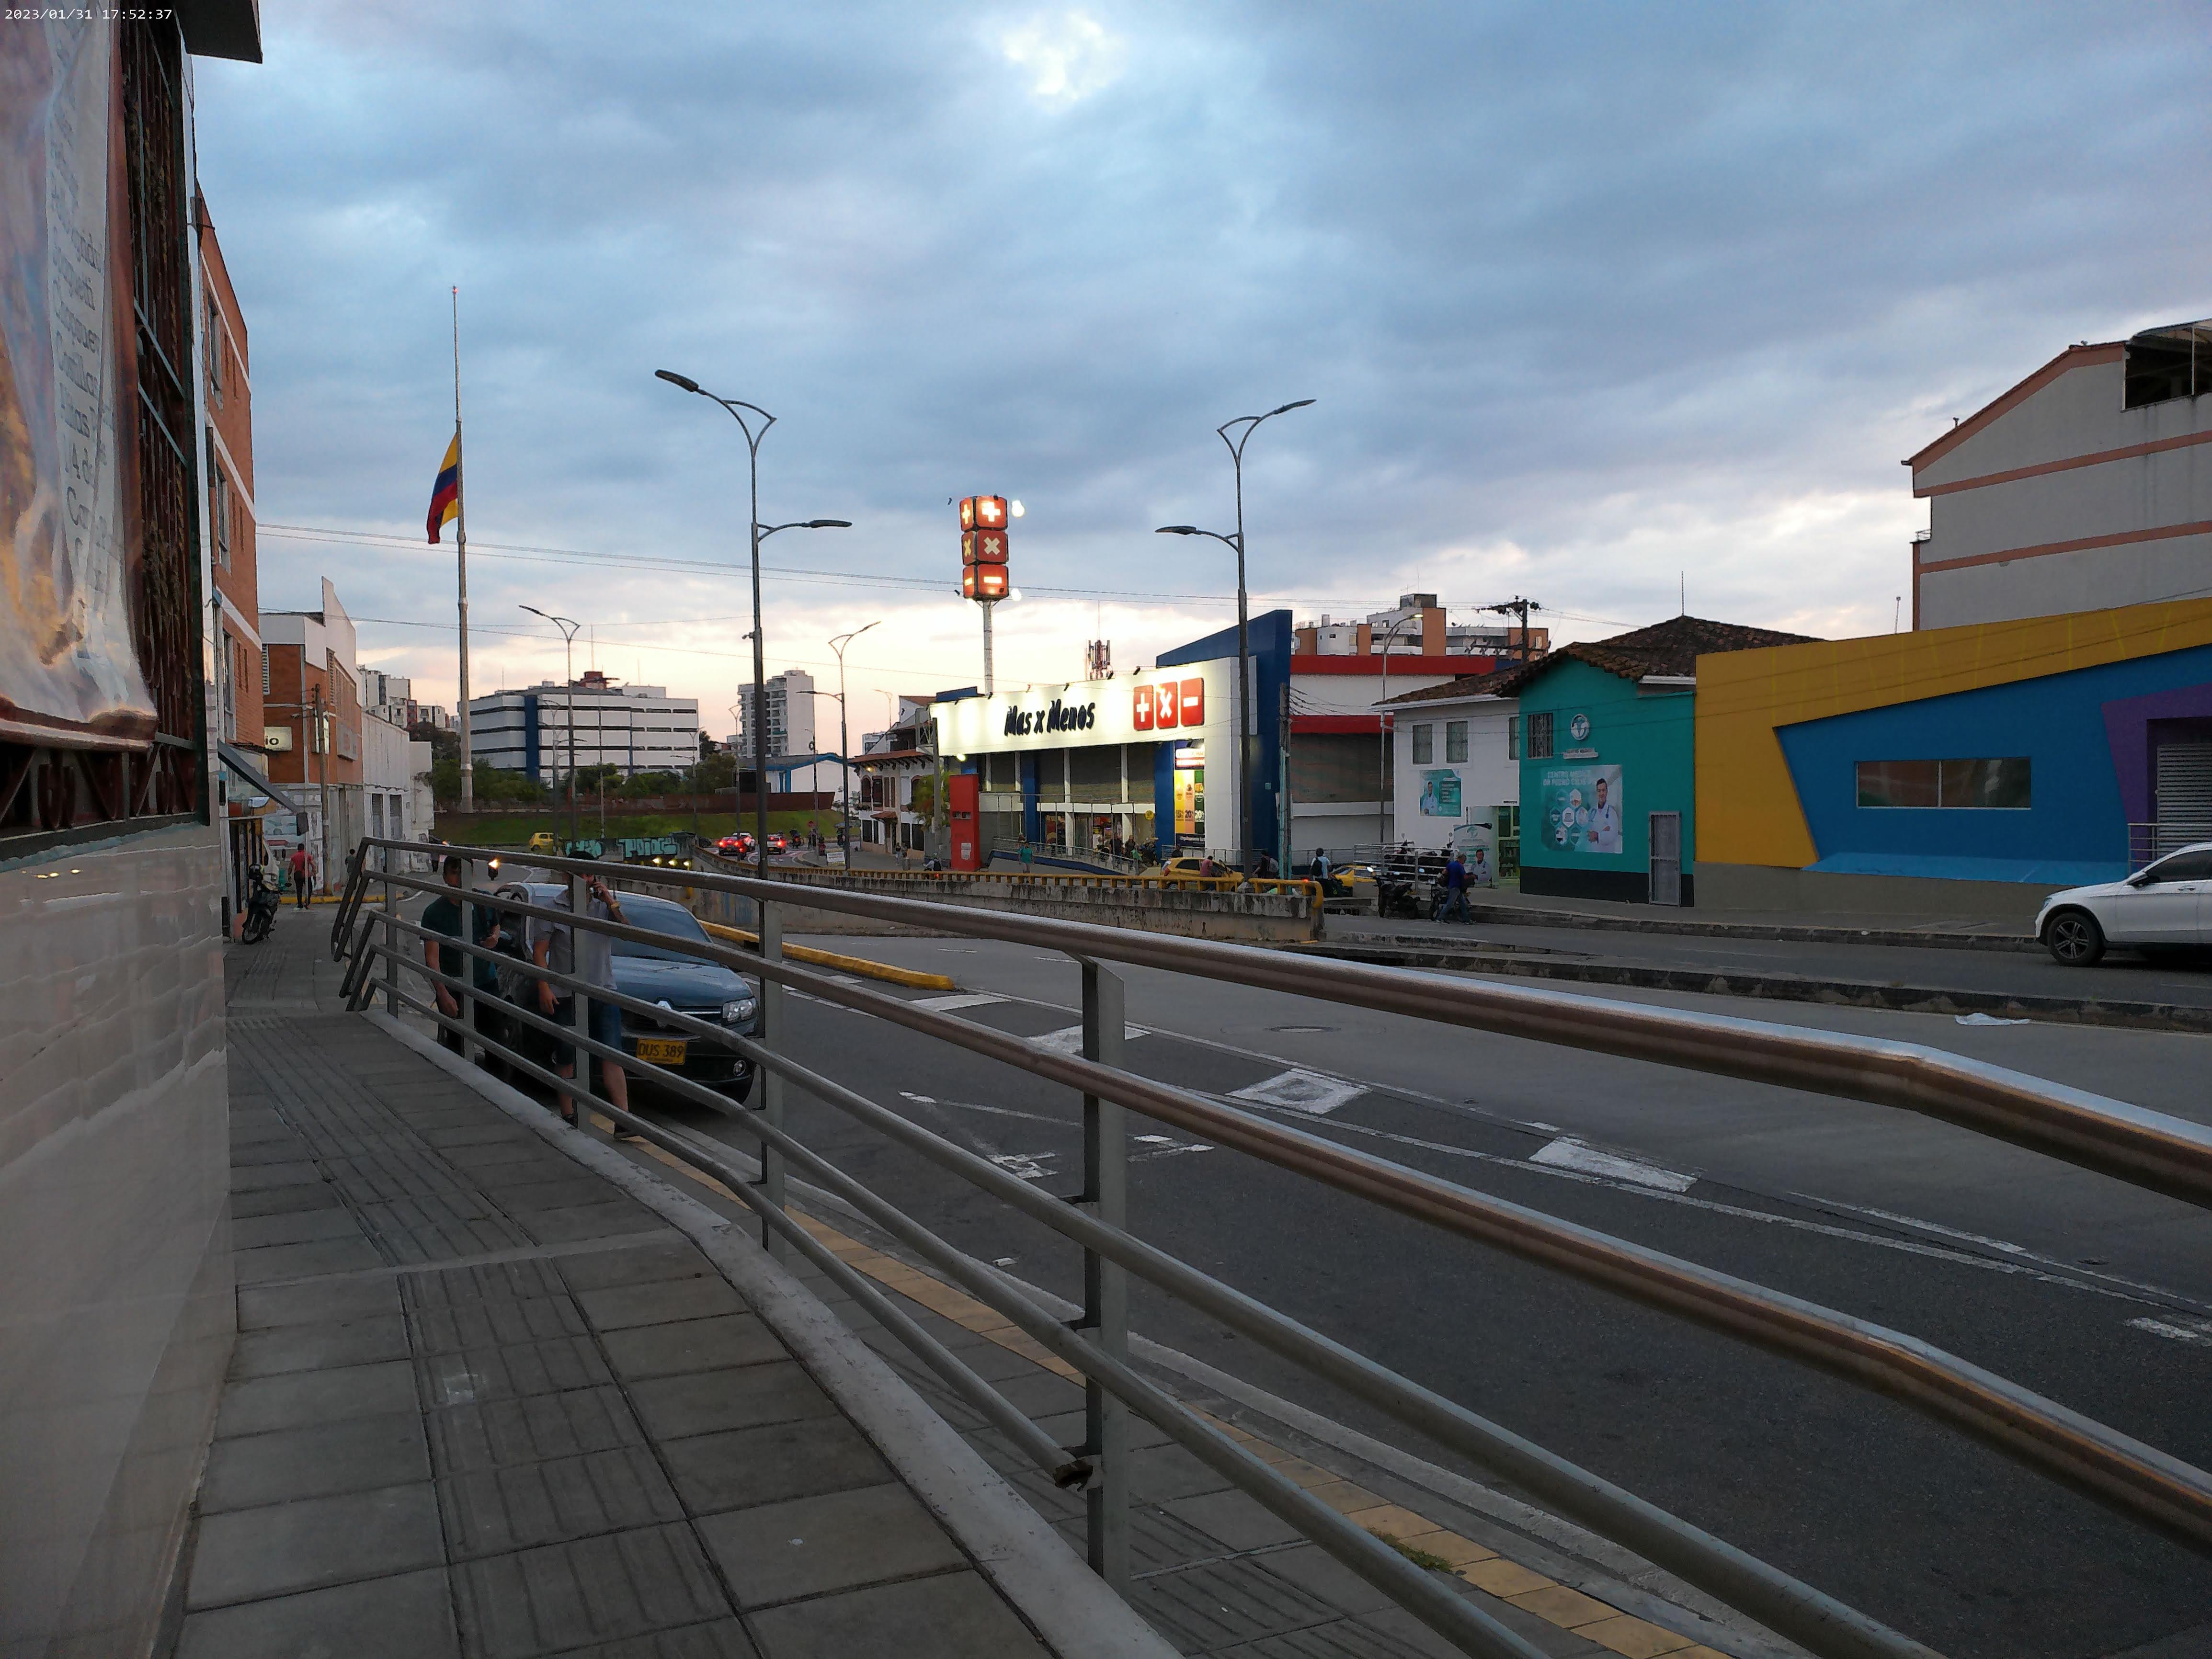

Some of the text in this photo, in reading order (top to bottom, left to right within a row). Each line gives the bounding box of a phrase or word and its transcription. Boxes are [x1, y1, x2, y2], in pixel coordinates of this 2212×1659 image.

[1004, 698, 1095, 737] Mas x Menos
[662, 1045, 684, 1058] 389
